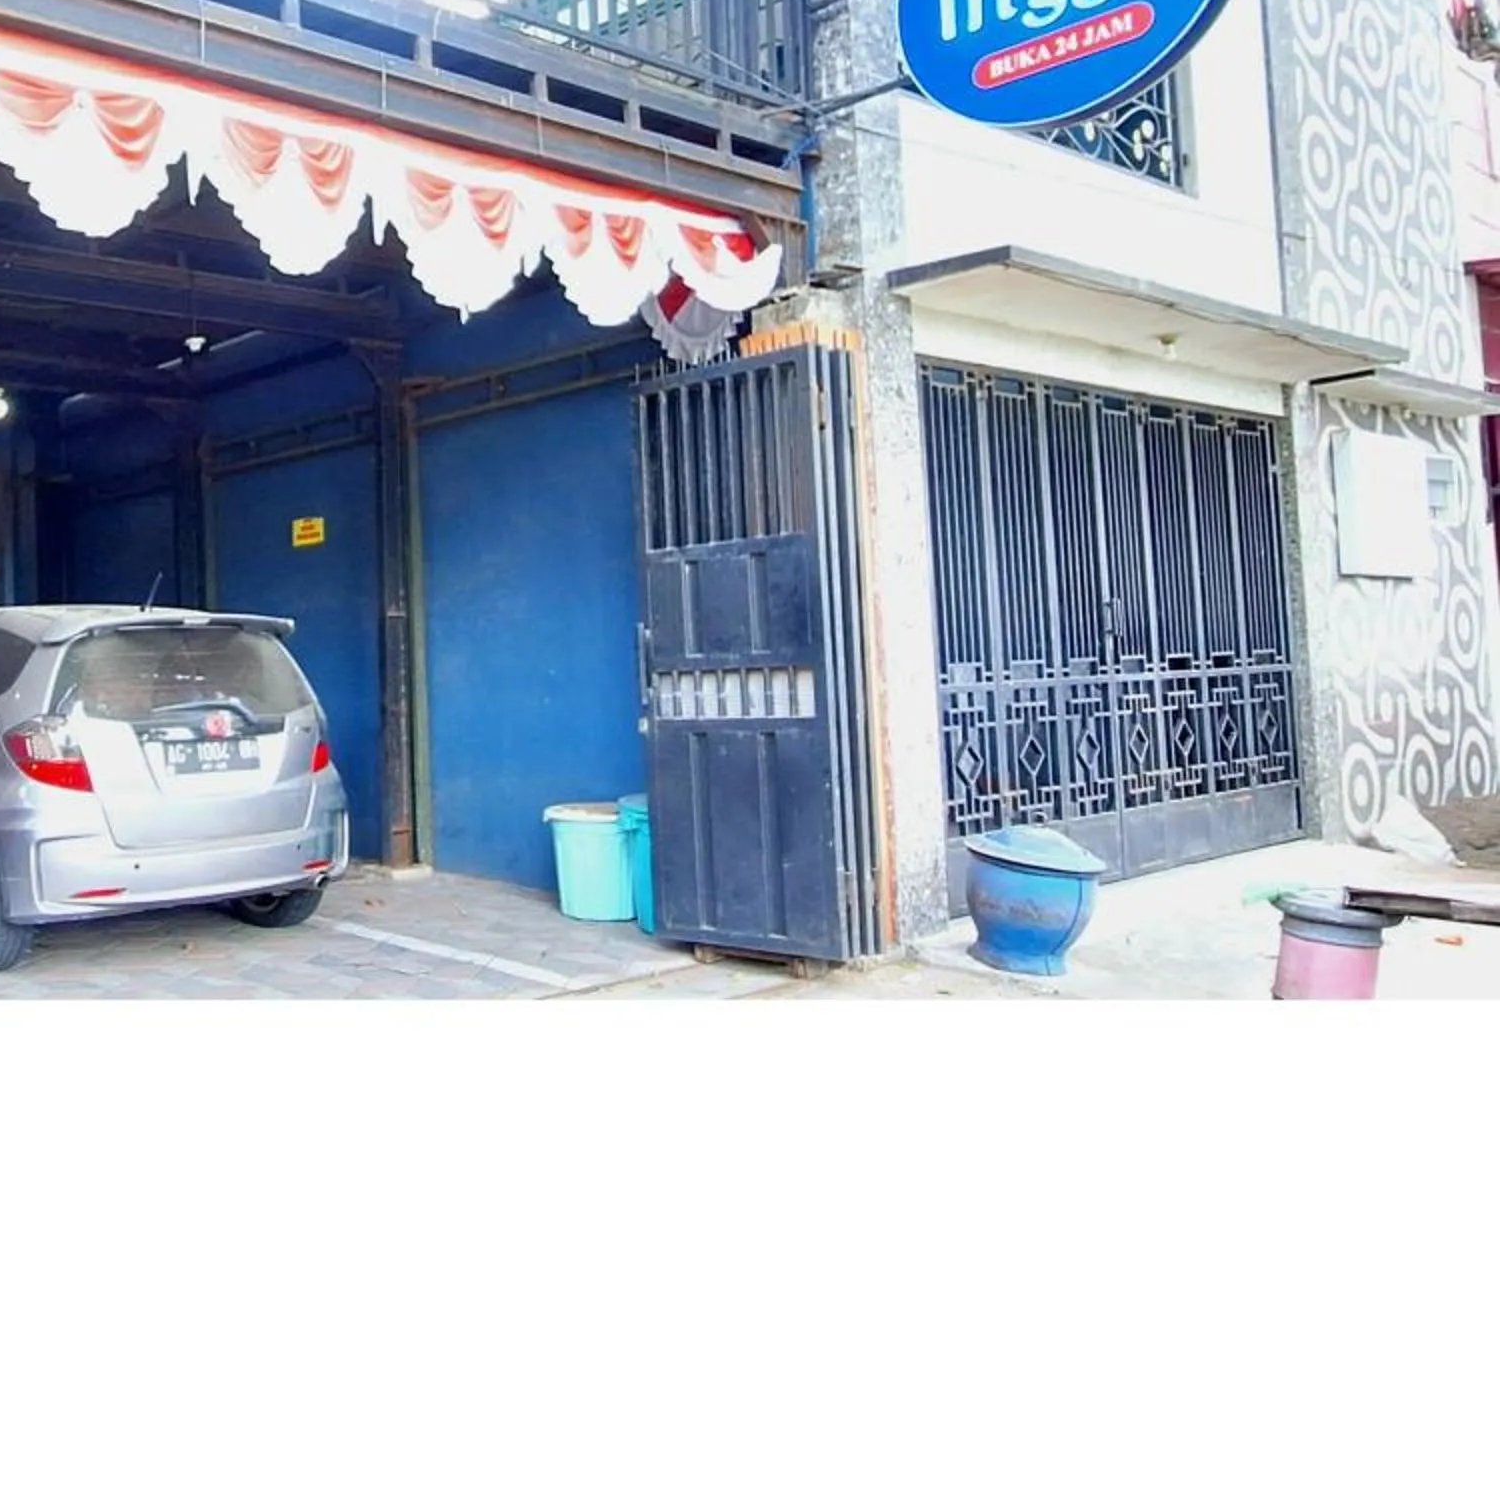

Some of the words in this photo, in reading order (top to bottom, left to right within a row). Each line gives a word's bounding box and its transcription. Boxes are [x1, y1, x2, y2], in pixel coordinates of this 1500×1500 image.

[989, 43, 1051, 79] BUKA
[1054, 32, 1079, 56] 24
[1082, 12, 1134, 47] JAM
